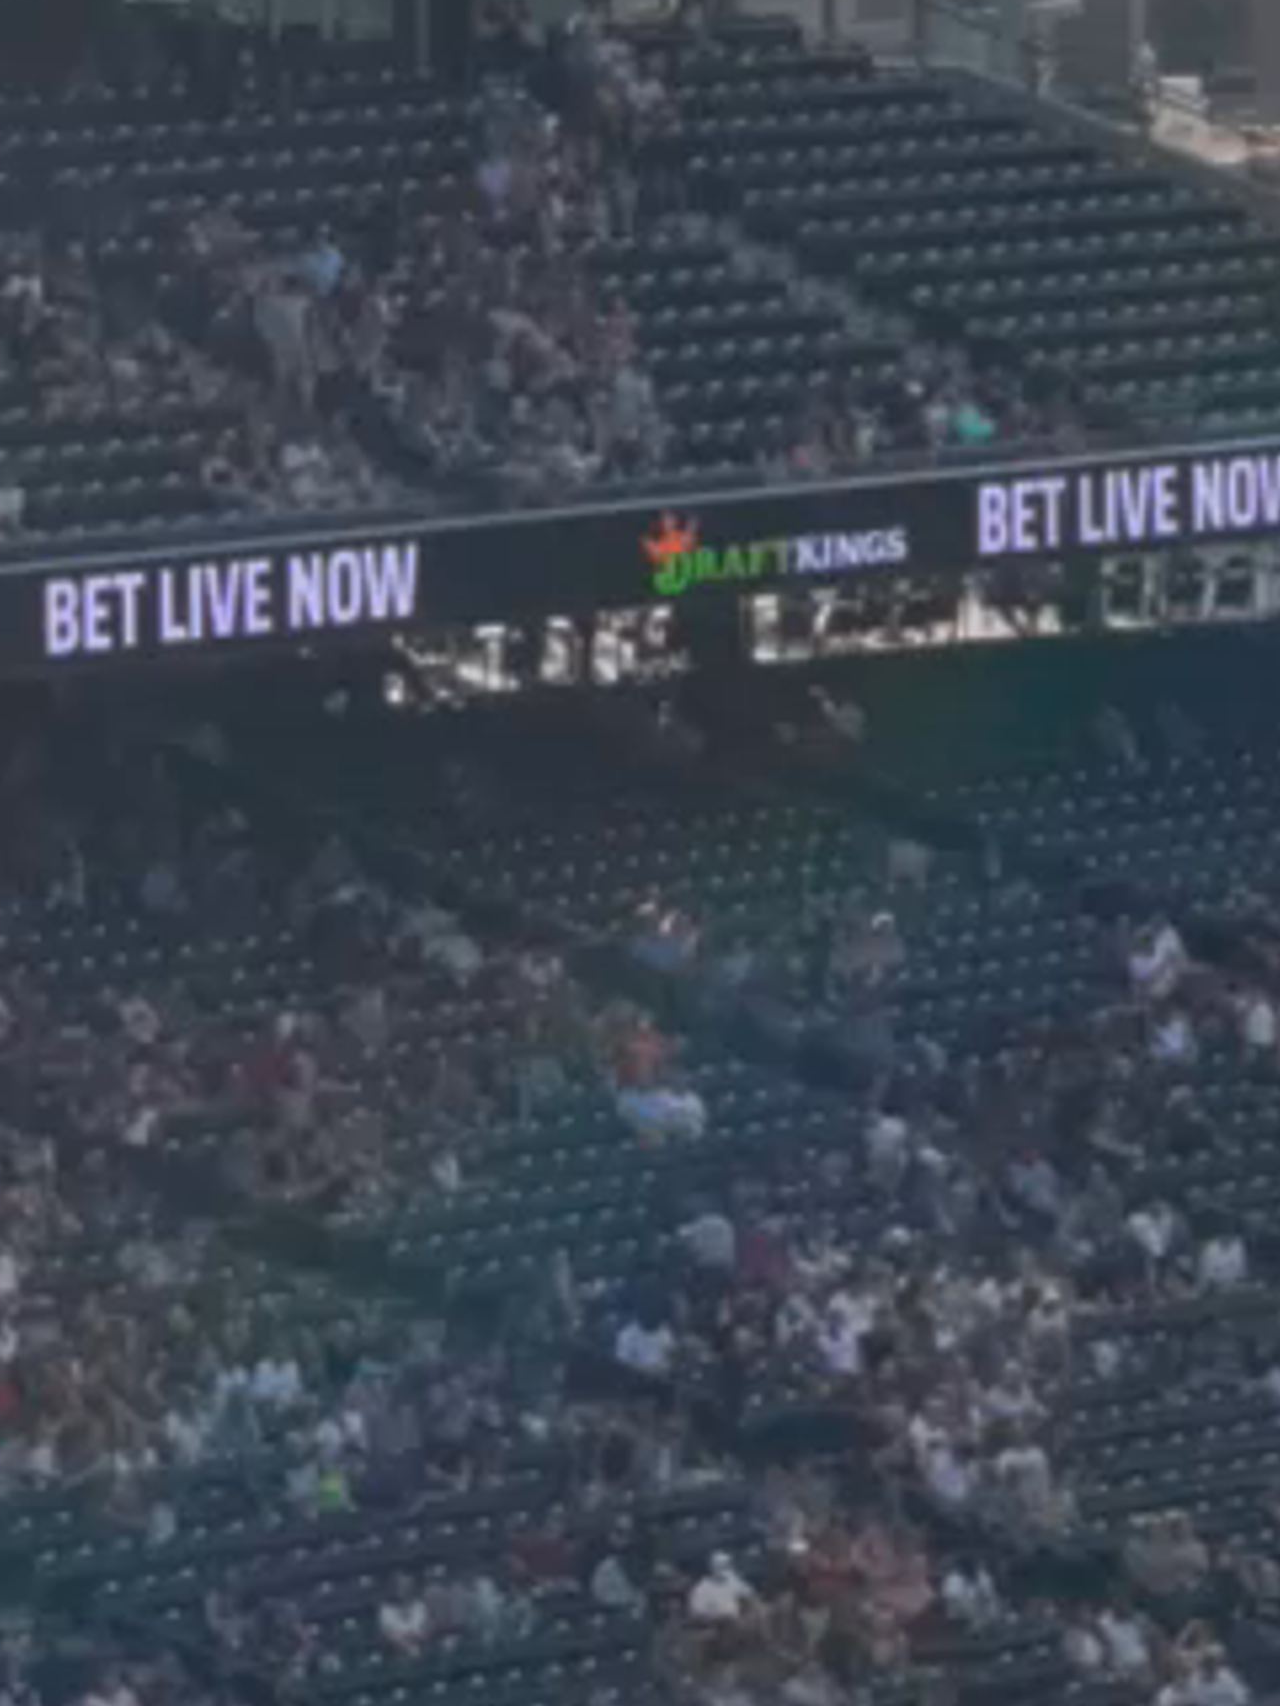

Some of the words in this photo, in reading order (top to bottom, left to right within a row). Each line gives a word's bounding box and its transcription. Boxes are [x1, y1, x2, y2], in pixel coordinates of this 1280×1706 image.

[978, 478, 1067, 555] BET
[1078, 465, 1179, 545] LIVE
[44, 574, 147, 656] BET
[159, 559, 272, 644] LIVE
[288, 543, 418, 629] NOW
